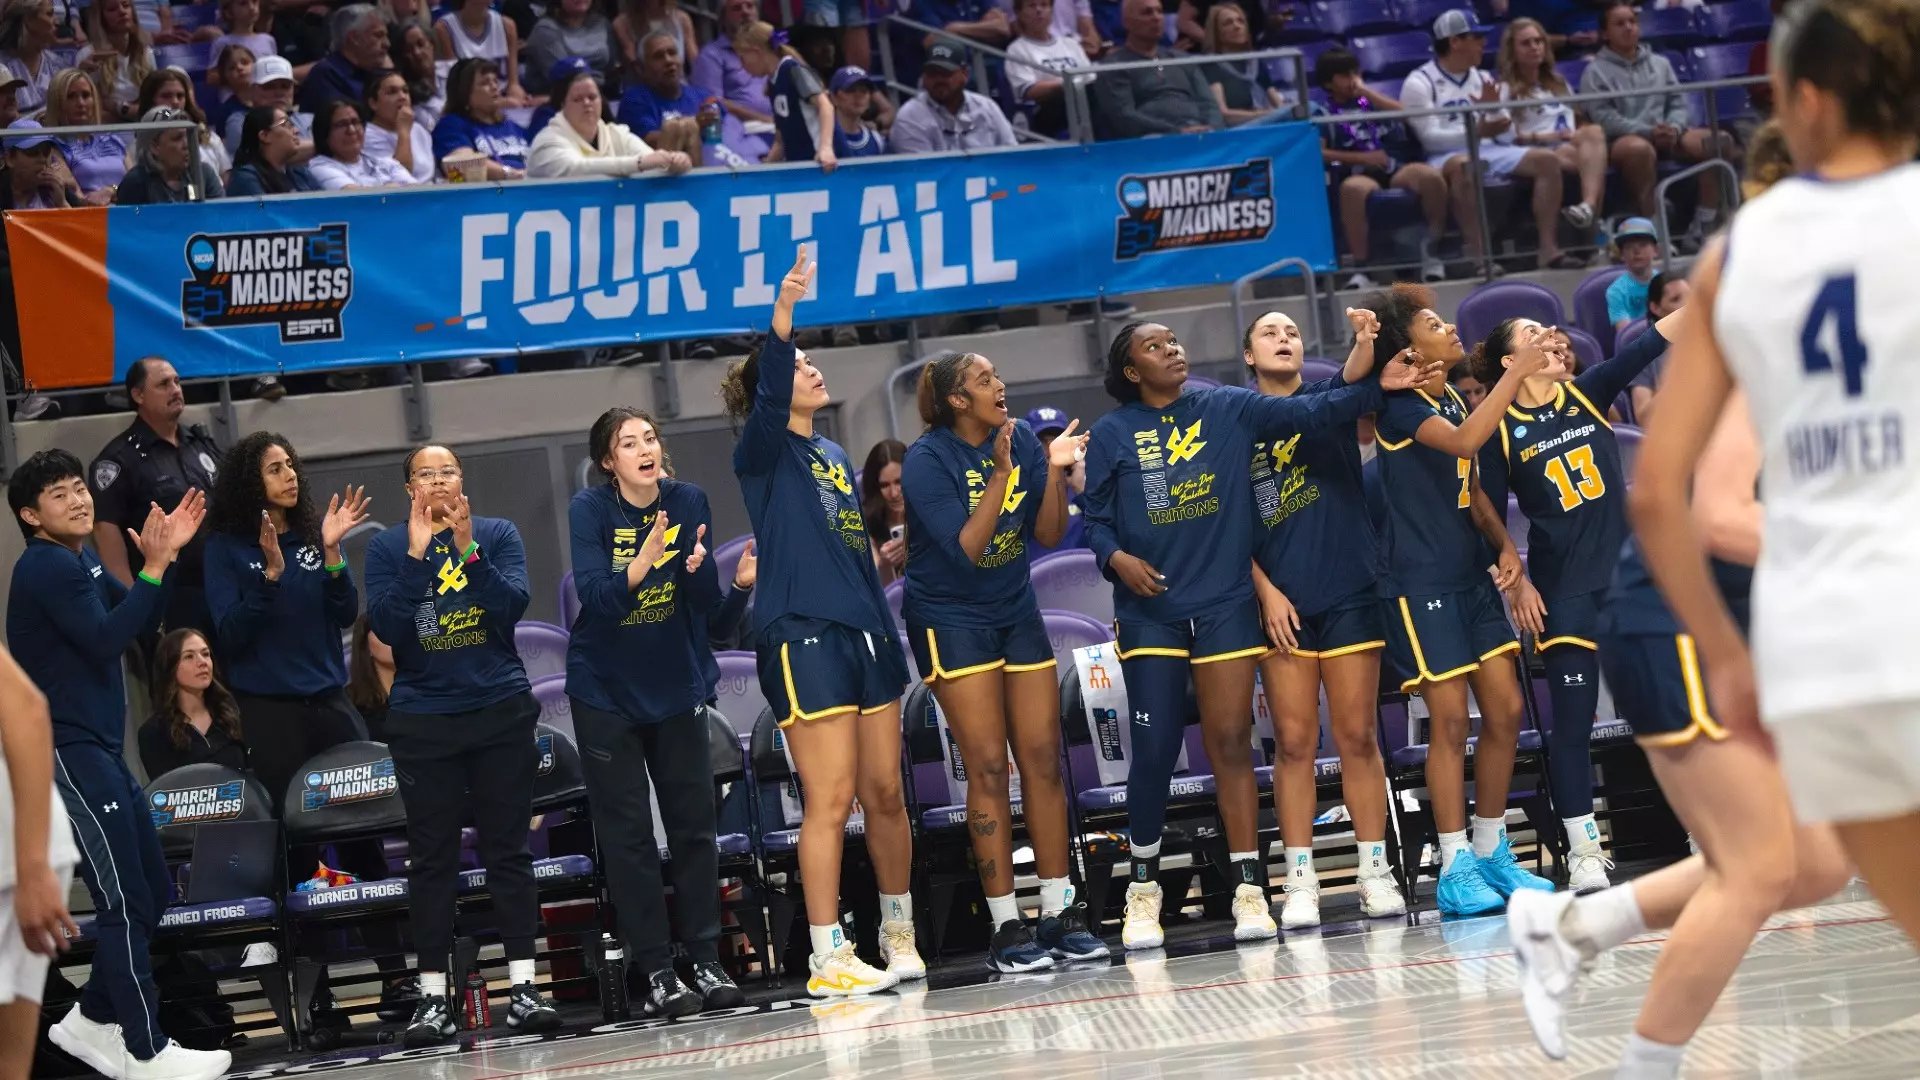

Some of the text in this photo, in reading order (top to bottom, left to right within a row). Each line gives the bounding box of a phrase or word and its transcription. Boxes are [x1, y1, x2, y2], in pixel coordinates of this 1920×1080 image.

[1148, 172, 1231, 209] MARCH
[1160, 198, 1272, 238] MADNESS
[217, 236, 303, 273] MARCH
[461, 177, 1018, 330] FOUR IT ALL
[231, 267, 349, 306] MADNESS
[287, 318, 335, 336] ESPN
[1800, 270, 1868, 396] 4
[1786, 411, 1904, 482] HUNTER
[1142, 471, 1170, 509] DIEGO
[1544, 444, 1605, 512] 13
[1147, 496, 1220, 525] TRITONS
[614, 528, 637, 544] UC
[976, 540, 1025, 568] RITONS
[420, 629, 488, 651] TRITONS
[322, 765, 372, 786] MARCH
[330, 775, 397, 799] MADNESS
[167, 787, 217, 806] MARCH
[1169, 782, 1204, 796] ROGS
[174, 798, 241, 819] MADNESS
[533, 864, 563, 878] OGS
[307, 883, 403, 906] HORNED FROGS
[158, 905, 246, 927] ORNED FROGS
